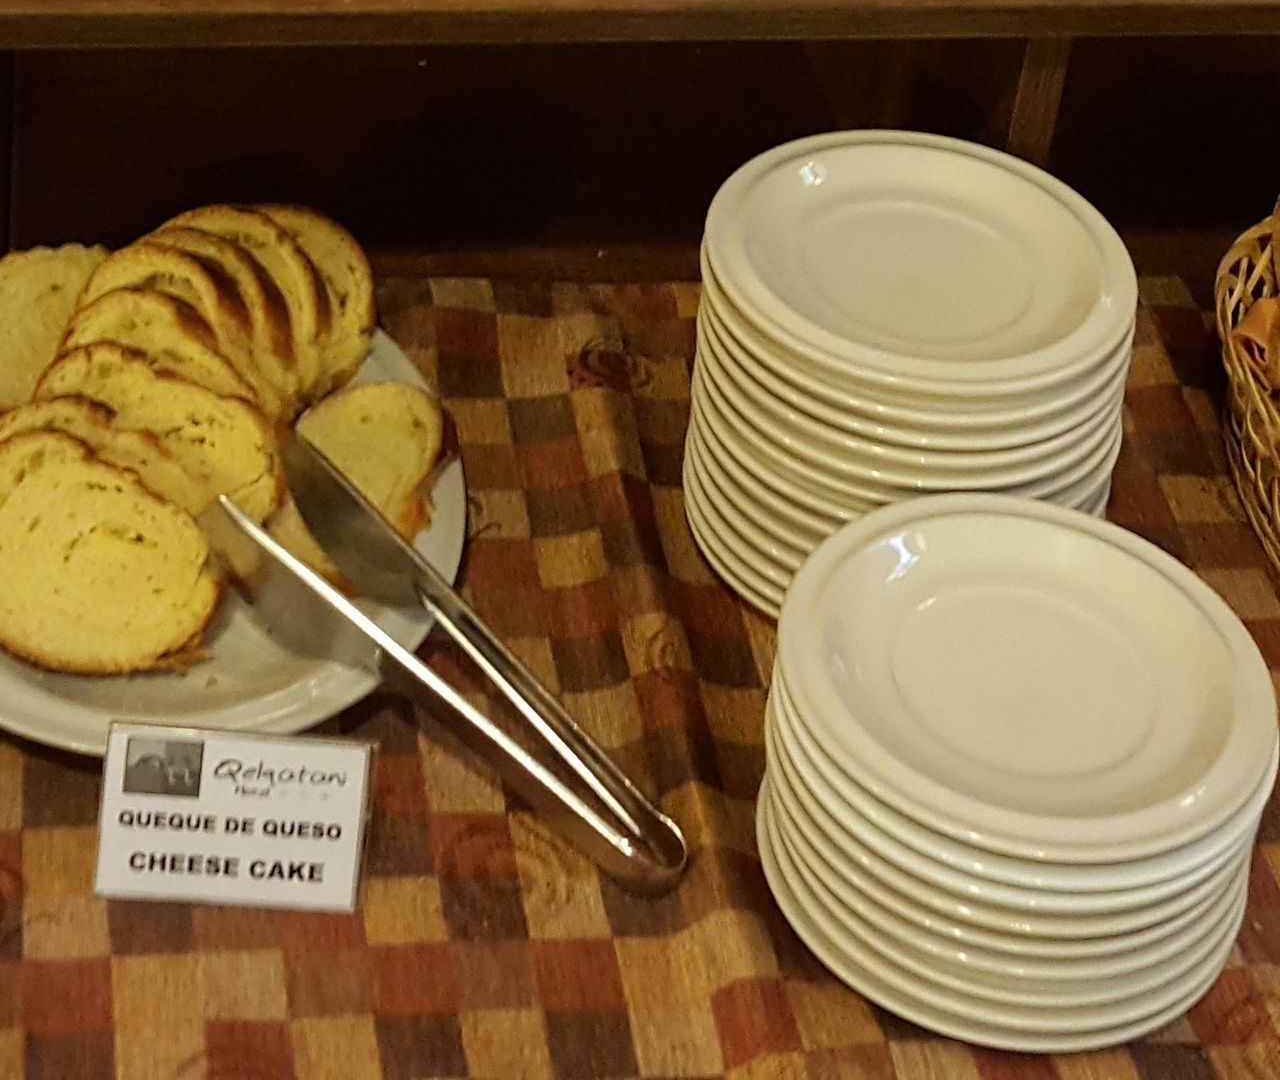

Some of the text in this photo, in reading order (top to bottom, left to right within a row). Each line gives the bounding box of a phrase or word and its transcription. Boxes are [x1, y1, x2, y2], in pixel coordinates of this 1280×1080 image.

[118, 809, 342, 841] QUEQUE DE QUESO
[129, 851, 325, 883] CHEESE CAKE
